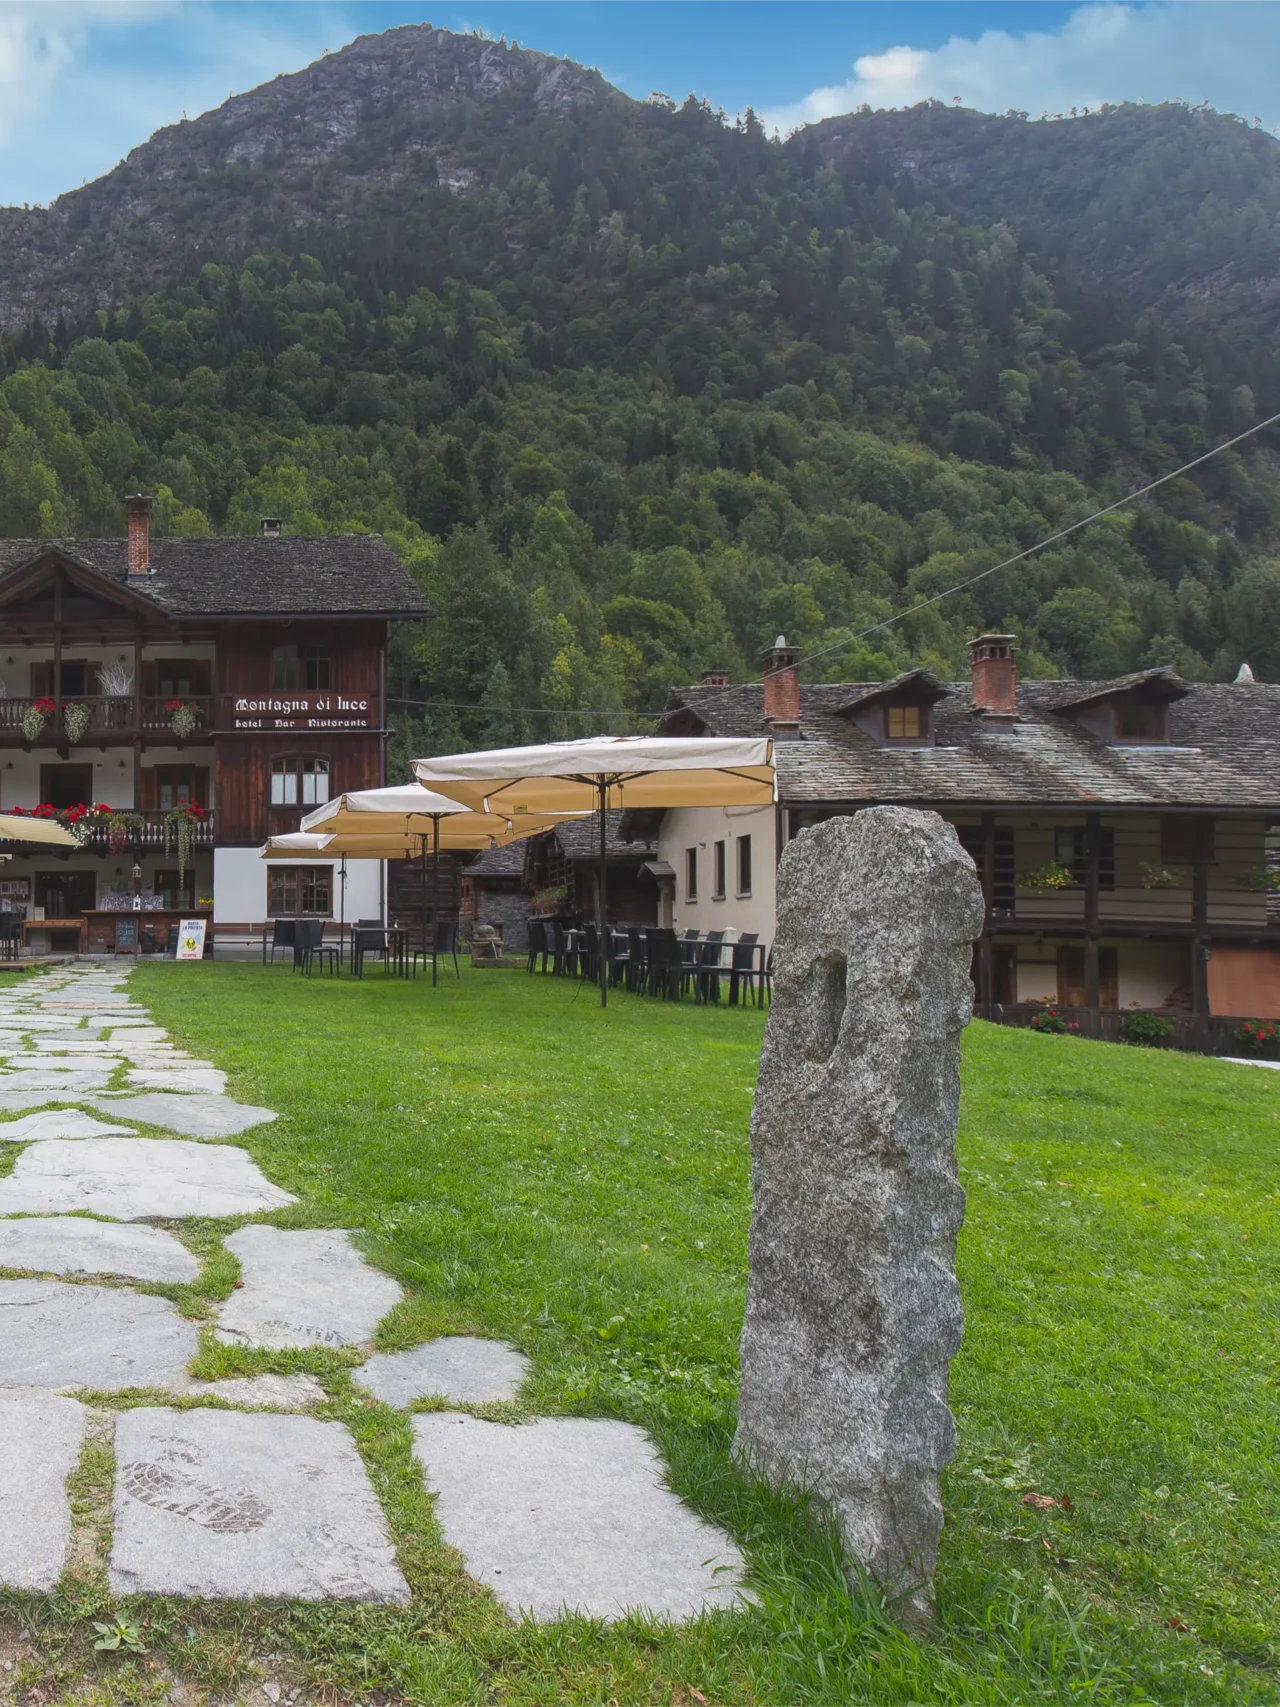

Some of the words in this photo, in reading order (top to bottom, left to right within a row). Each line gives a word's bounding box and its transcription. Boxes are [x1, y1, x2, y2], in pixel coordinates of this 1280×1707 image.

[235, 697, 309, 714] Montagna
[316, 695, 331, 710] di
[337, 696, 368, 710] luce
[274, 719, 296, 727] Bar
[307, 718, 367, 727] Ristorante
